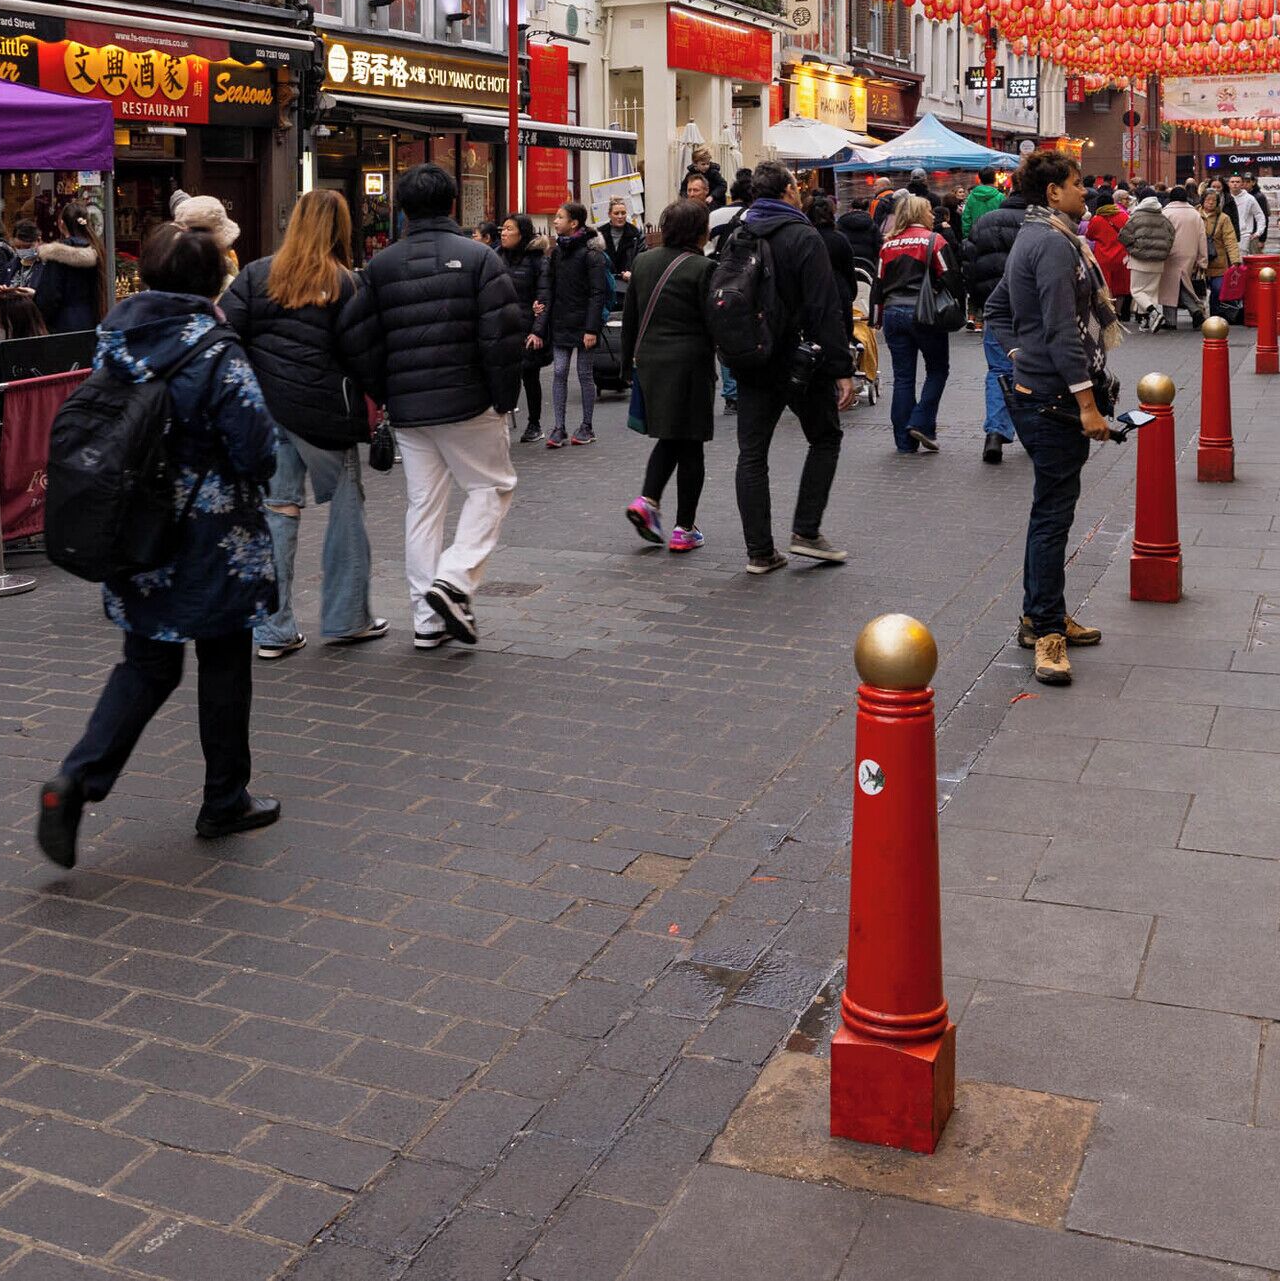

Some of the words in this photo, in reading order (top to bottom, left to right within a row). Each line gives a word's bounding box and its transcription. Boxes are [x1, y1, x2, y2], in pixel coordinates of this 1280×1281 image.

[14, 17, 36, 30] Street
[72, 46, 185, 95] 文興酒家
[351, 50, 409, 88] 蜀香格
[428, 68, 447, 85] SHU
[448, 69, 473, 89] XIANG
[475, 76, 487, 90] GE
[487, 77, 506, 93] HOT
[213, 72, 273, 105] Seasons
[121, 101, 190, 118] RESTAURANT
[1208, 156, 1217, 167] P
